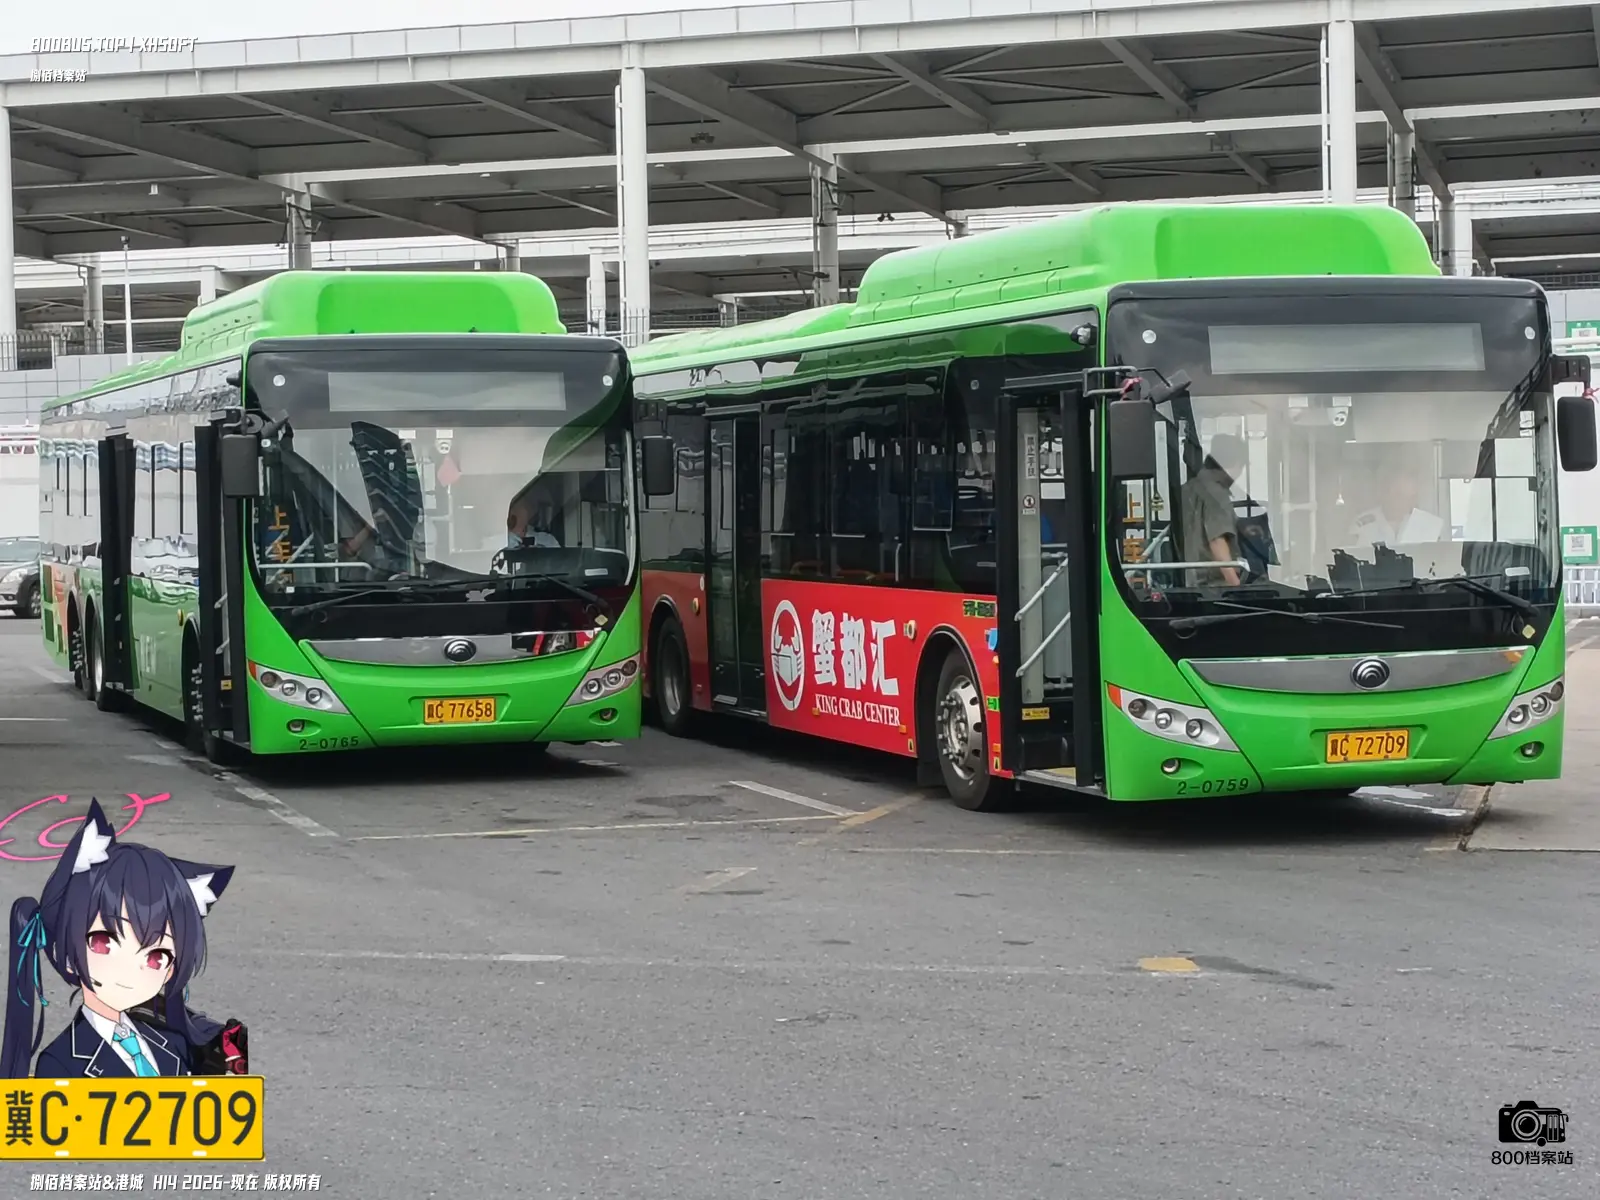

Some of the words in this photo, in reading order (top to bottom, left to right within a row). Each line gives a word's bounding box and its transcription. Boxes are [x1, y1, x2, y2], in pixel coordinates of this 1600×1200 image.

[812, 609, 899, 696] 蟹都汇
[449, 701, 493, 718] 77658
[815, 694, 838, 715] KING
[839, 698, 863, 719] CRAB
[864, 702, 901, 727] CENTER
[299, 735, 359, 750] 2-0765
[1355, 735, 1405, 756] 72709
[1176, 777, 1249, 795] 2-0759
